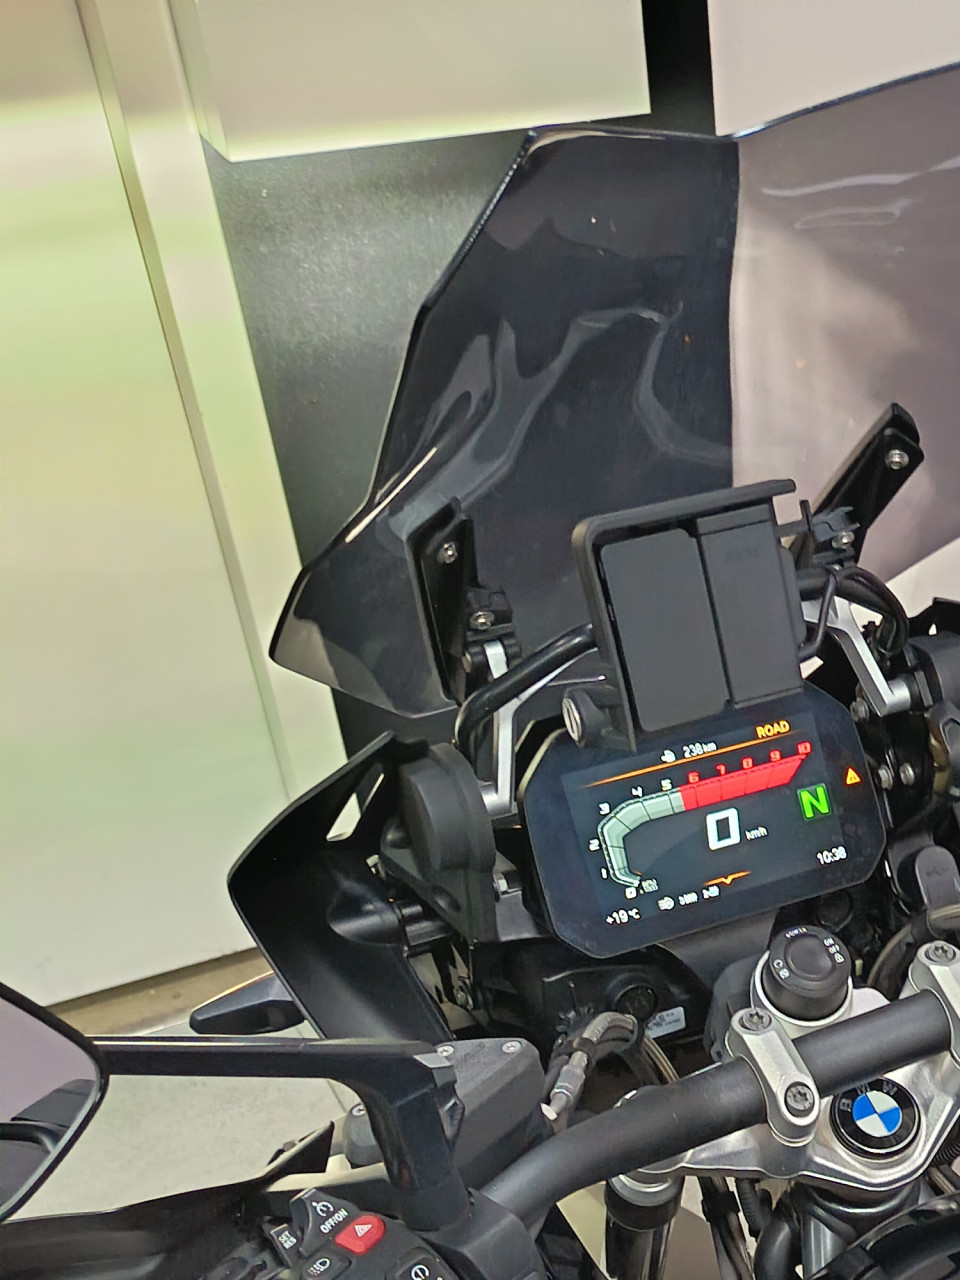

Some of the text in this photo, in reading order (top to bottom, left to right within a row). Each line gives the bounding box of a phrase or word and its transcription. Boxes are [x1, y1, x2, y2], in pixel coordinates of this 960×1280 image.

[756, 720, 790, 738] ROAD
[797, 742, 812, 754] 10
[770, 750, 781, 761] 9
[743, 758, 752, 769] 8
[716, 765, 726, 775] 7
[688, 772, 699, 783] 6
[661, 779, 672, 791] 5
[631, 786, 643, 797] 4
[799, 785, 830, 818] N
[599, 802, 610, 815] 3
[706, 807, 740, 850] 0
[589, 839, 600, 851] 2
[816, 846, 847, 865] 10:38
[601, 868, 608, 879] 1
[625, 887, 637, 899] 0
[319, 1208, 349, 1233] OFF/ON
